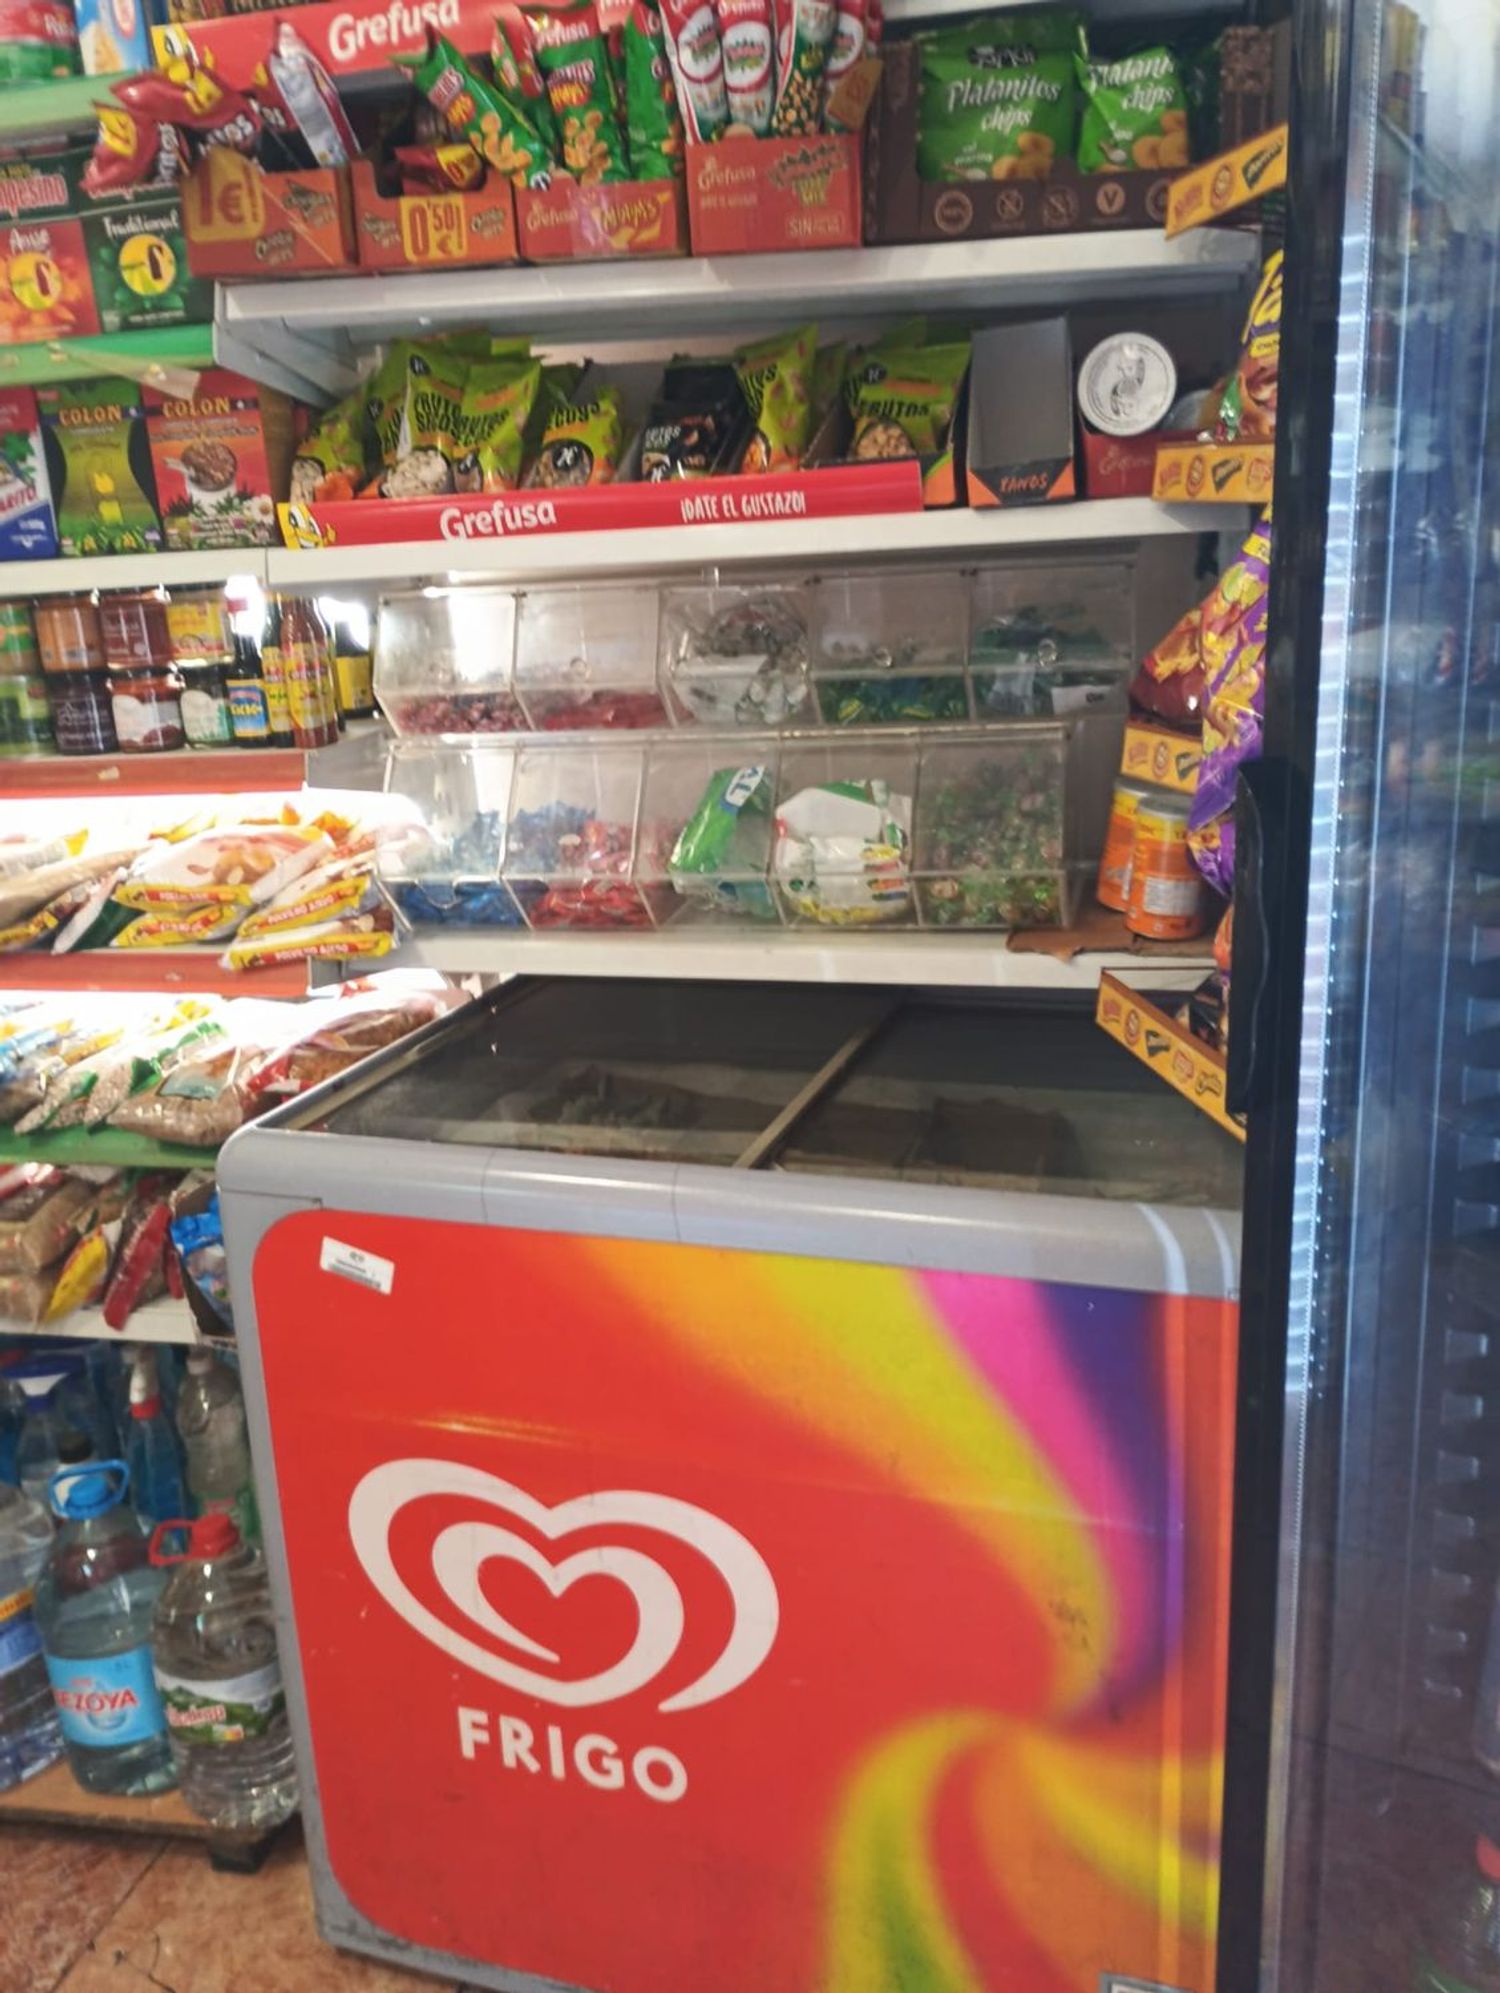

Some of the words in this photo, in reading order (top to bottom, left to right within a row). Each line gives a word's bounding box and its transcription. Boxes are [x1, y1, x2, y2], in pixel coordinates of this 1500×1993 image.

[328, 0, 460, 62] Grefusa
[948, 75, 1061, 112] Platanitos
[1121, 82, 1174, 113] chips
[981, 104, 1033, 137] chips
[59, 405, 122, 427] COLON
[162, 397, 231, 419] COLON
[722, 493, 737, 516] EL
[440, 501, 557, 542] Grefusa
[52, 1688, 138, 1713] EZOYA
[457, 1706, 688, 1802] FRIGO
